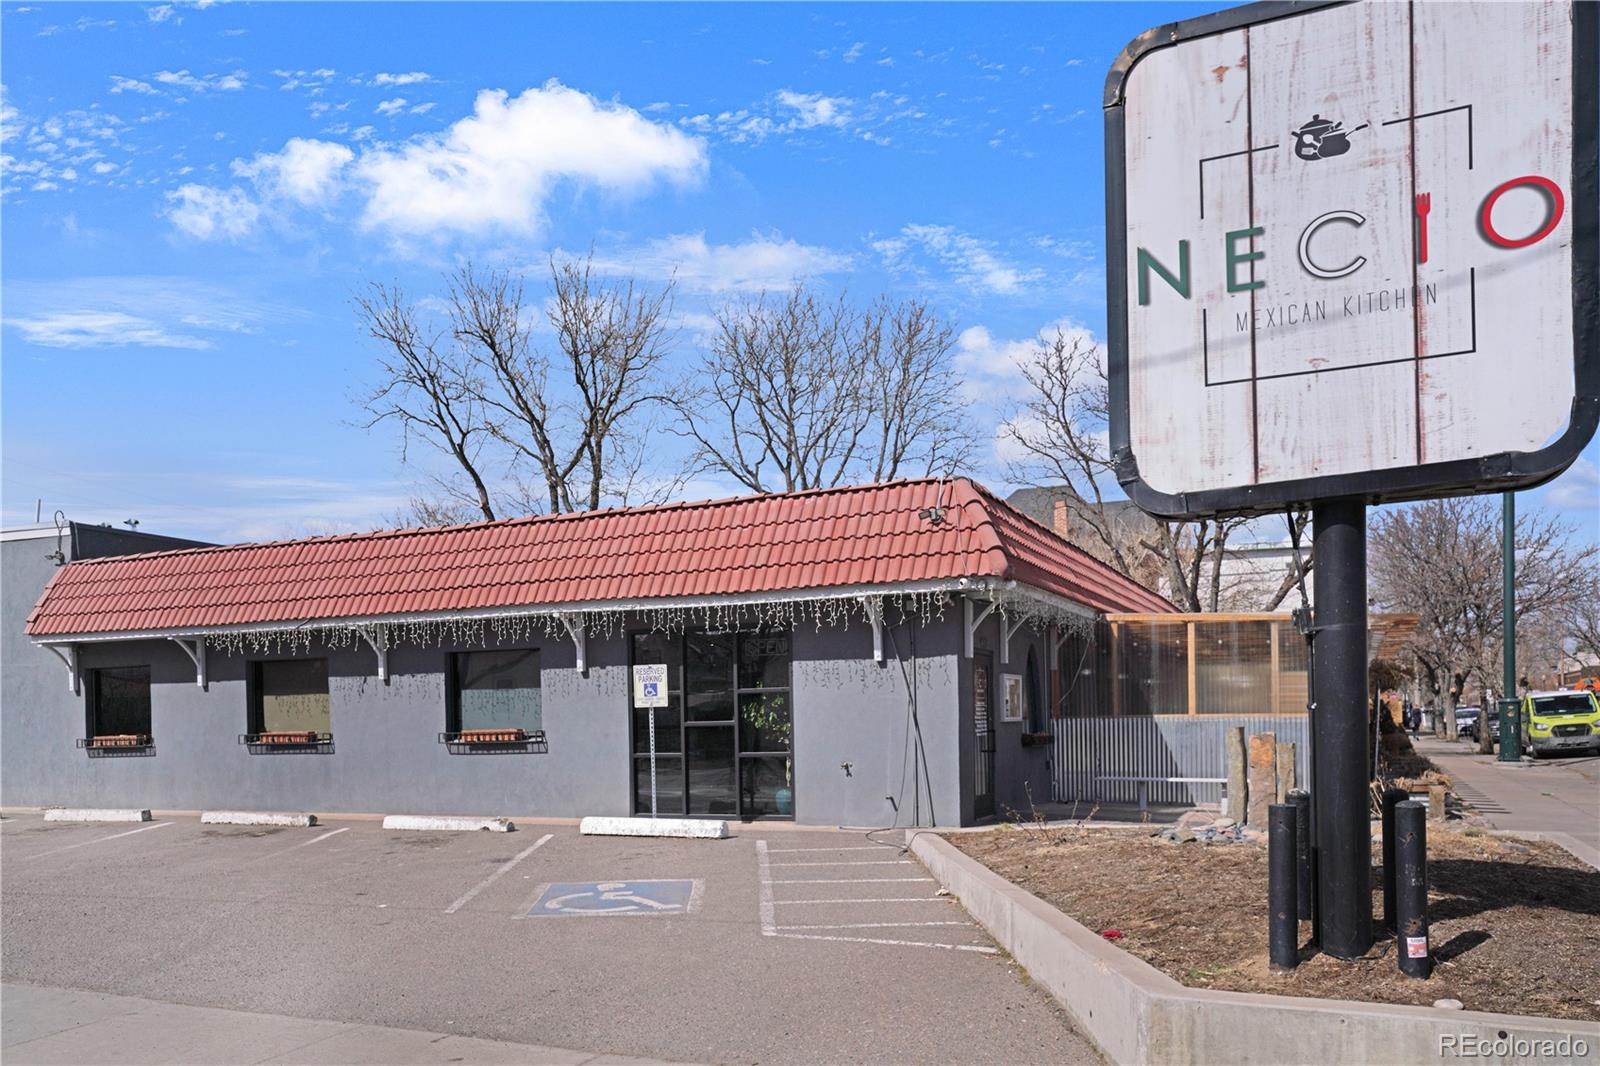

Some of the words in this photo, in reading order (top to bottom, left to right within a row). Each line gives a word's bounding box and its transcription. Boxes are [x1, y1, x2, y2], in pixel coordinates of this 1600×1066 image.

[1236, 299, 1327, 333] MEXICAN
[635, 667, 665, 675] RESERVED
[638, 675, 663, 683] PARKING
